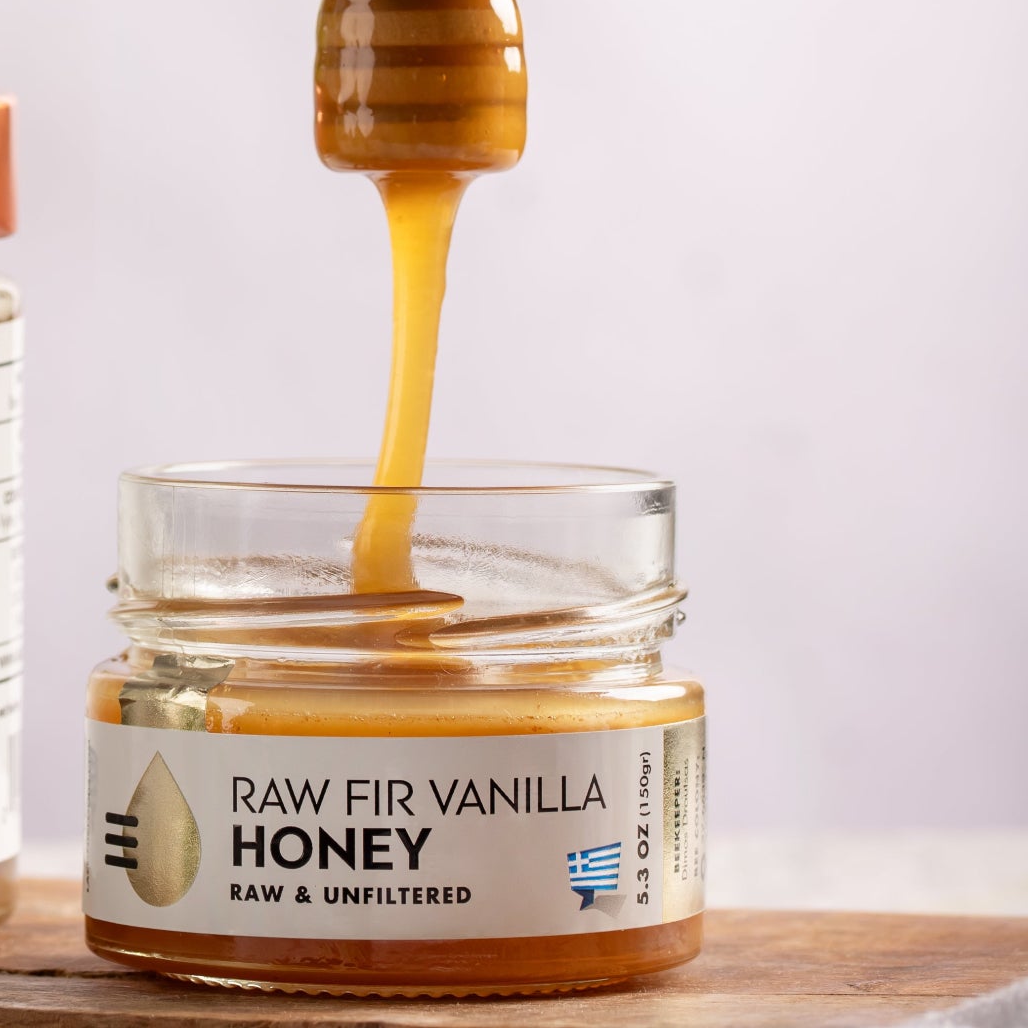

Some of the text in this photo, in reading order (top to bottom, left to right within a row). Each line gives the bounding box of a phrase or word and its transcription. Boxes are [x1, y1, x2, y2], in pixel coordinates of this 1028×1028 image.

[231, 773, 607, 817] RAW FIR VANILLA
[232, 824, 433, 872] HONEY
[637, 751, 652, 906] 5.3 OZ (150gr)
[229, 883, 473, 905] RAW & UNFILTERED
